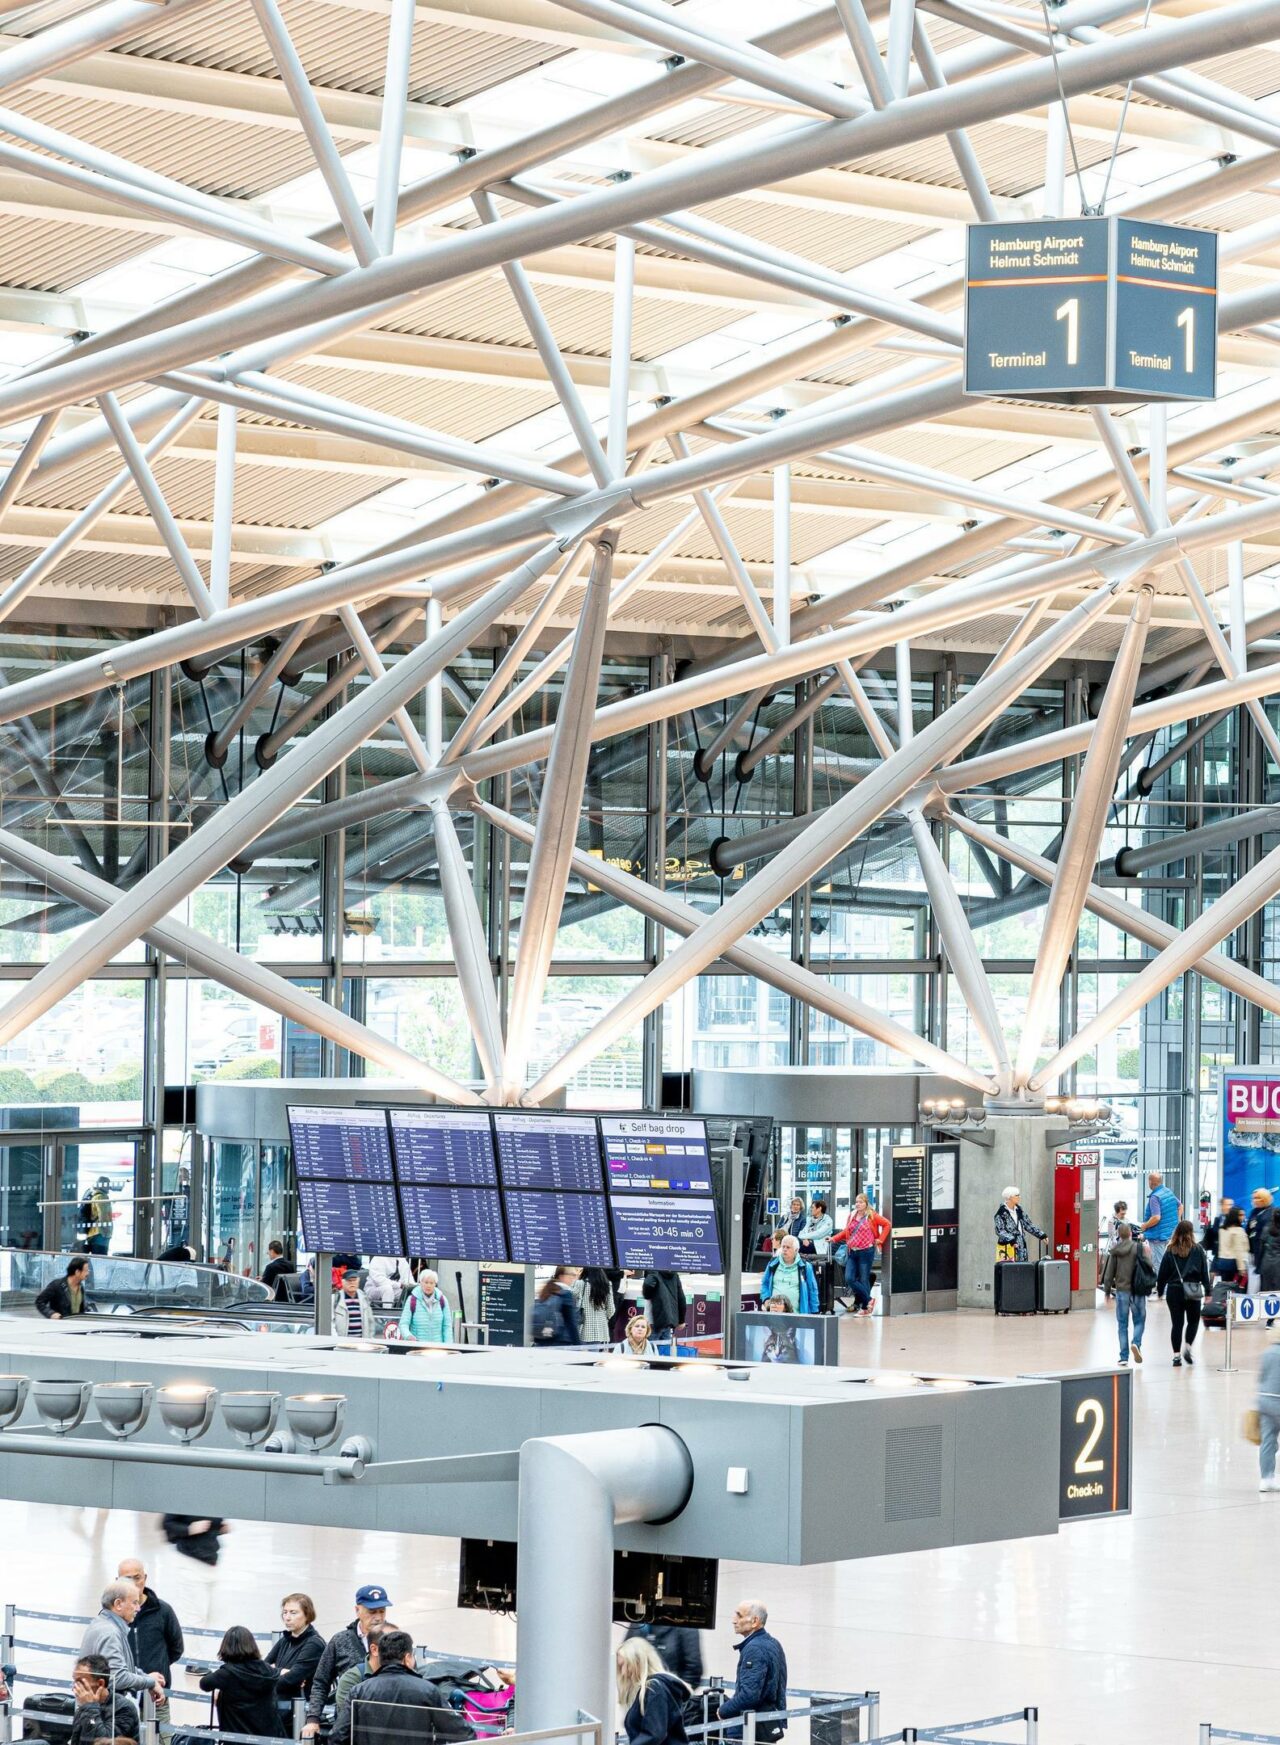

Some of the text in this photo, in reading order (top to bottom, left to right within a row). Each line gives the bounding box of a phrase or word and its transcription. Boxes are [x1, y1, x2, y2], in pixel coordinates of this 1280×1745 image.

[990, 236, 1084, 253] Hamburg Airport
[1131, 236, 1198, 259] Hamburg Airport
[990, 252, 1079, 268] Helmut Schmidt
[1130, 253, 1195, 274] Helmut Schmidt
[1056, 298, 1078, 365] 1
[1177, 307, 1194, 373] 1
[988, 351, 1046, 368] Terminal
[1129, 351, 1171, 370] Terminal
[631, 1122, 685, 1134] Self bag drop
[1077, 1154, 1093, 1164] SOS
[652, 1226, 678, 1237] 30-45
[1074, 1399, 1104, 1474] 2
[1067, 1482, 1103, 1499] Check-in
